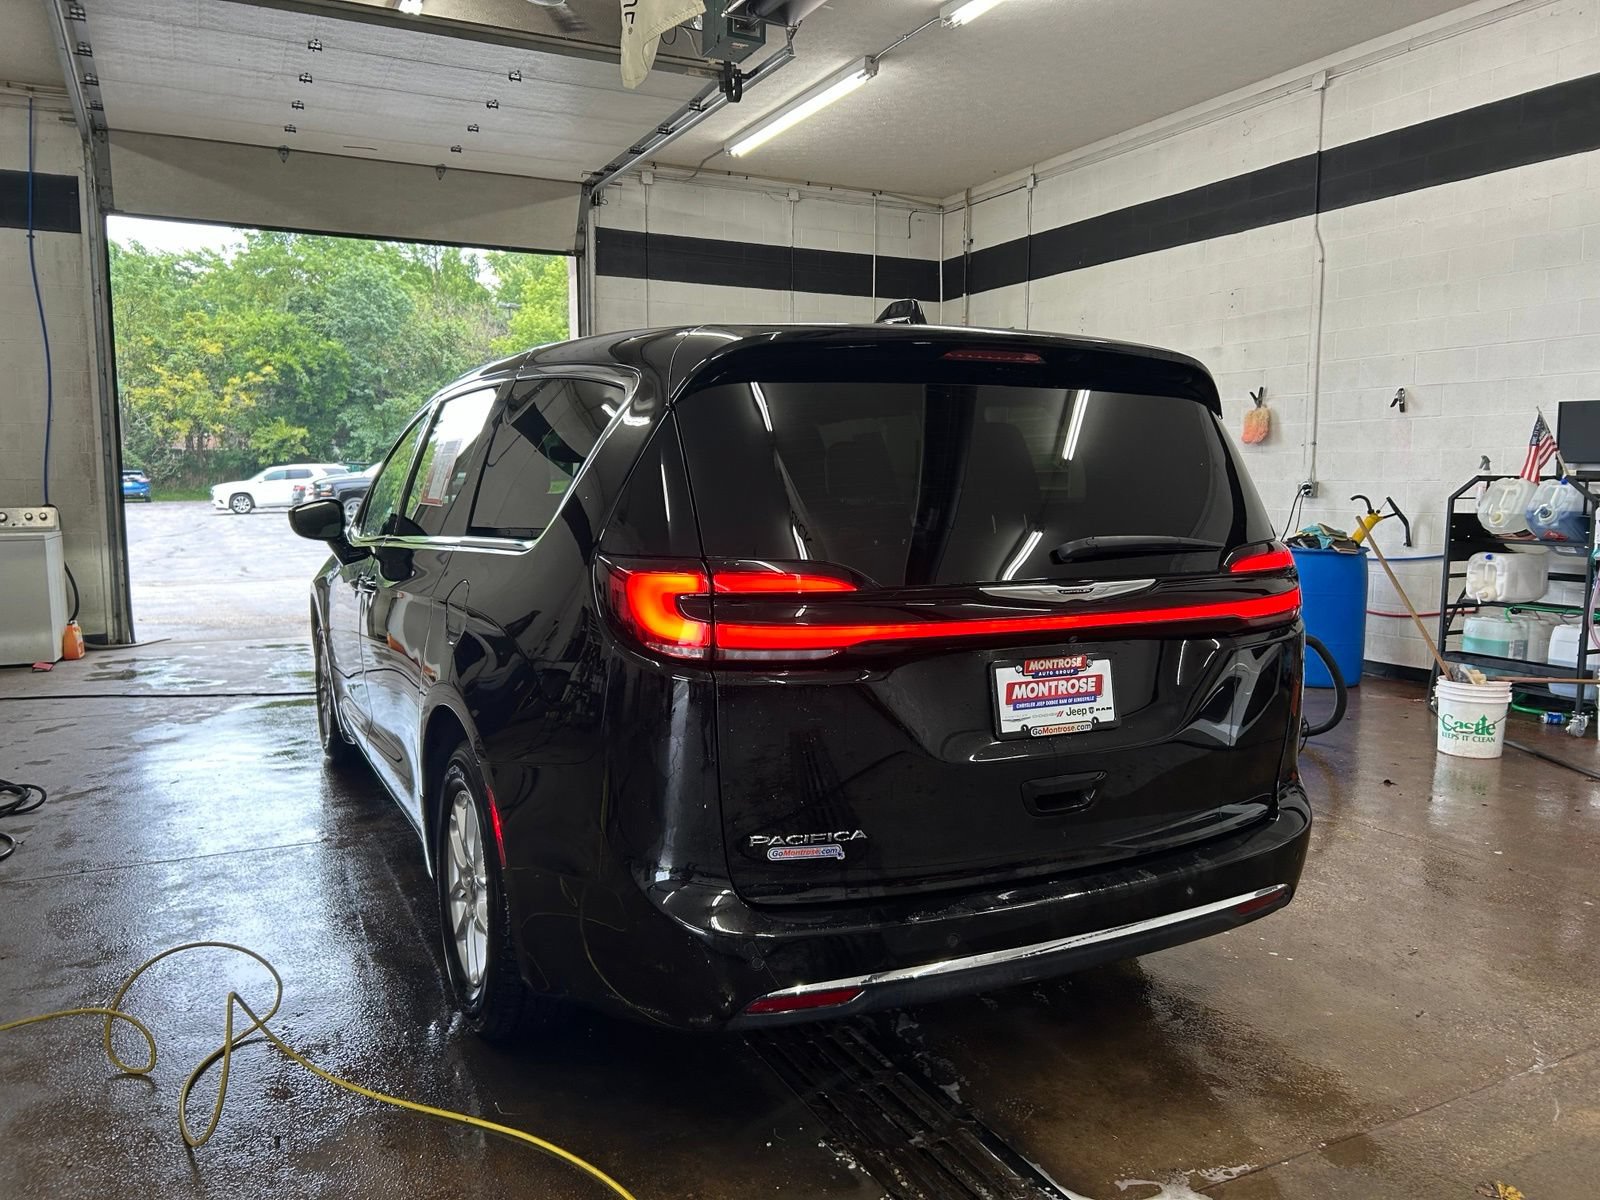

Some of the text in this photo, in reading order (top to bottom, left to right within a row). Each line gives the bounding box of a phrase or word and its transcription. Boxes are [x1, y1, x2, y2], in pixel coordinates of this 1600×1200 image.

[1029, 656, 1082, 670] MONTROSE
[1012, 677, 1096, 699] MONTROSE
[1066, 706, 1087, 717] Jeep
[1032, 724, 1092, 736] GoMontrose.com
[1442, 714, 1496, 736] Castle
[1442, 732, 1460, 740] KEEPS
[749, 830, 868, 846] PACIFICA
[772, 847, 838, 857] GoMontrose.com
